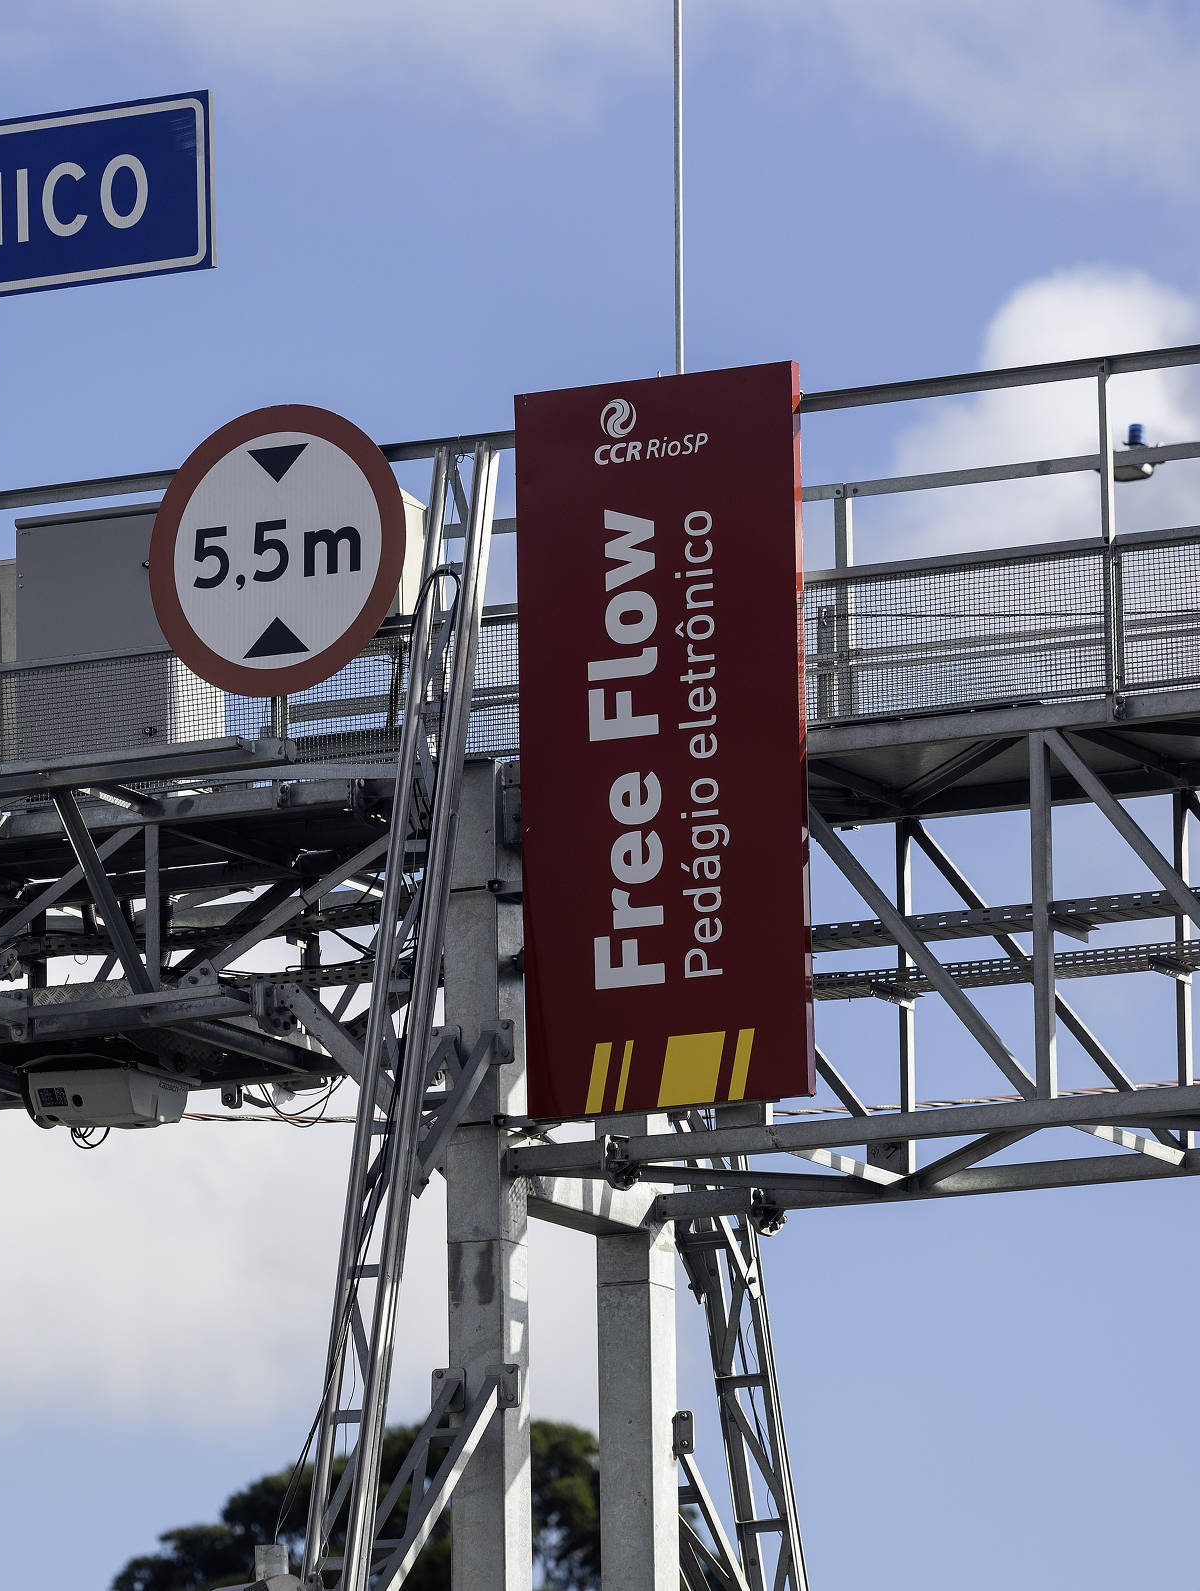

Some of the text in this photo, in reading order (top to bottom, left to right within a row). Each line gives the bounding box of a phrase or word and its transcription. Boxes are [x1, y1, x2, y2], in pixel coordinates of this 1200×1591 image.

[594, 432, 709, 466] CCR RioSP
[587, 508, 666, 991] Free Flow
[674, 509, 731, 979] Pedágio eletrônico
